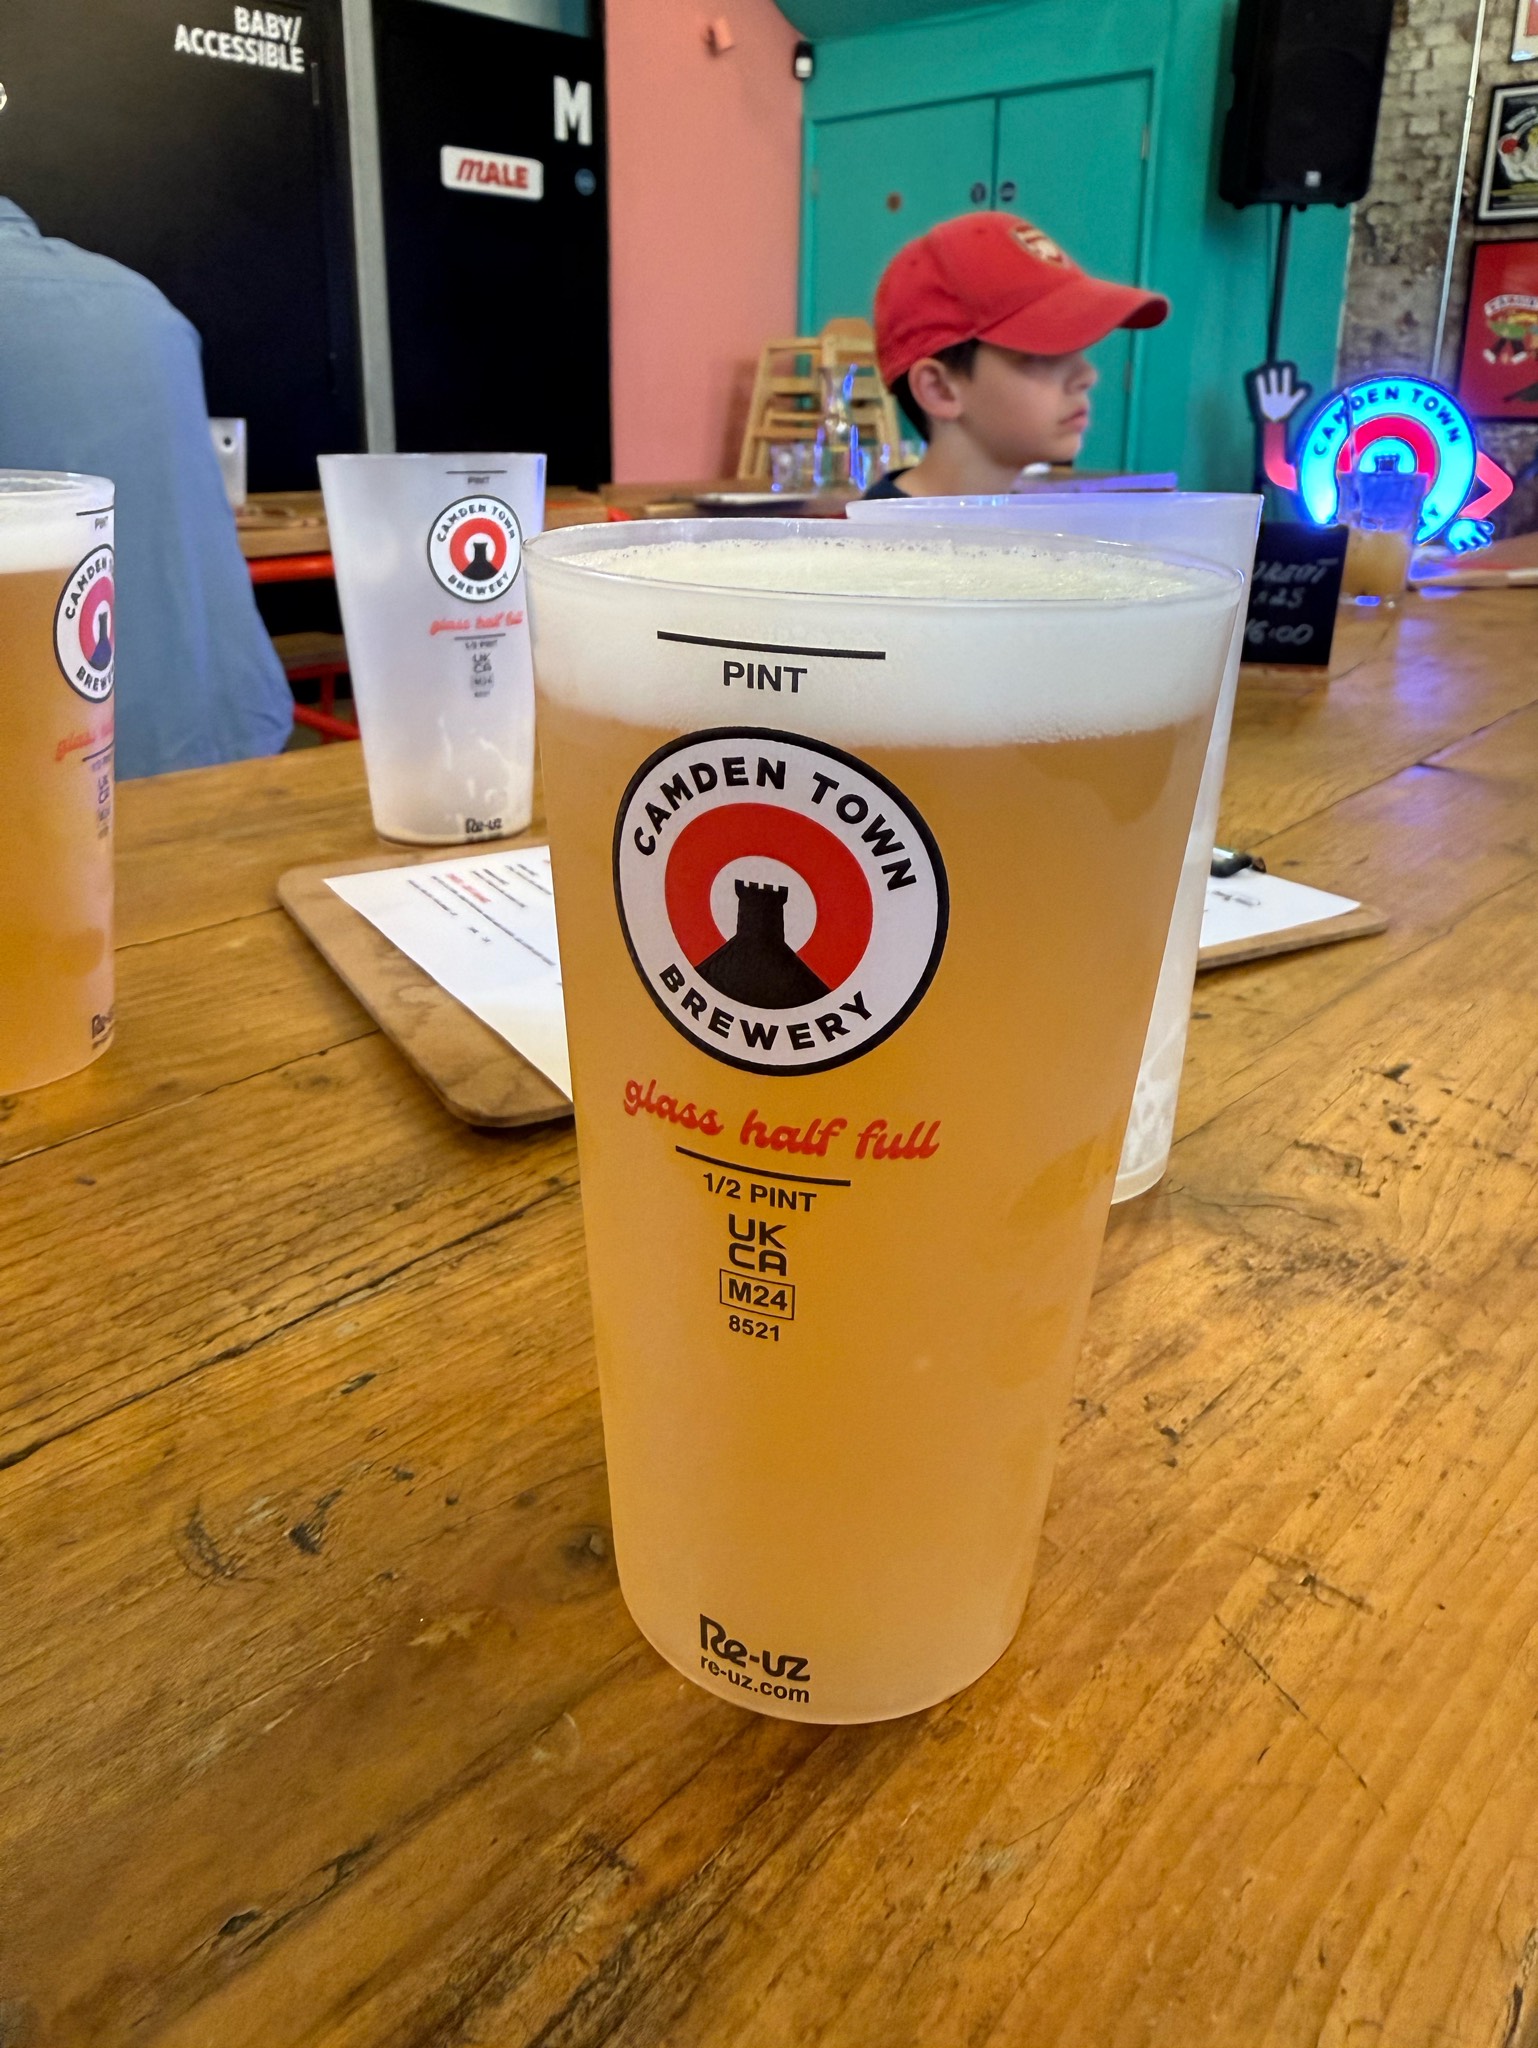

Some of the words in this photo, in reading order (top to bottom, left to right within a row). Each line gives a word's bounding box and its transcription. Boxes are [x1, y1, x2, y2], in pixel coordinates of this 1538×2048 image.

[234, 5, 302, 45] BABY/
[174, 24, 305, 73] ACCESSIBLE
[553, 74, 593, 146] M
[457, 157, 529, 189] MALE
[1313, 386, 1400, 456] CAMDEN
[1412, 388, 1461, 443] TOWN
[437, 504, 487, 543] CAMDEN
[65, 557, 107, 619] CAMDEN
[722, 660, 808, 693] PINT
[633, 756, 787, 857] CAMDEN
[809, 772, 918, 892] TOWN
[658, 962, 873, 1052] BREWERY
[623, 1078, 725, 1137] glass
[739, 1108, 849, 1158] half
[854, 1118, 942, 1161] full
[702, 1171, 742, 1200] 1/2
[750, 1182, 818, 1213] PINT
[728, 1213, 788, 1250] UK
[728, 1242, 788, 1277] CA
[728, 1278, 788, 1312] M24
[728, 1315, 781, 1342] 8521
[700, 1655, 811, 1704] re-uz.com
